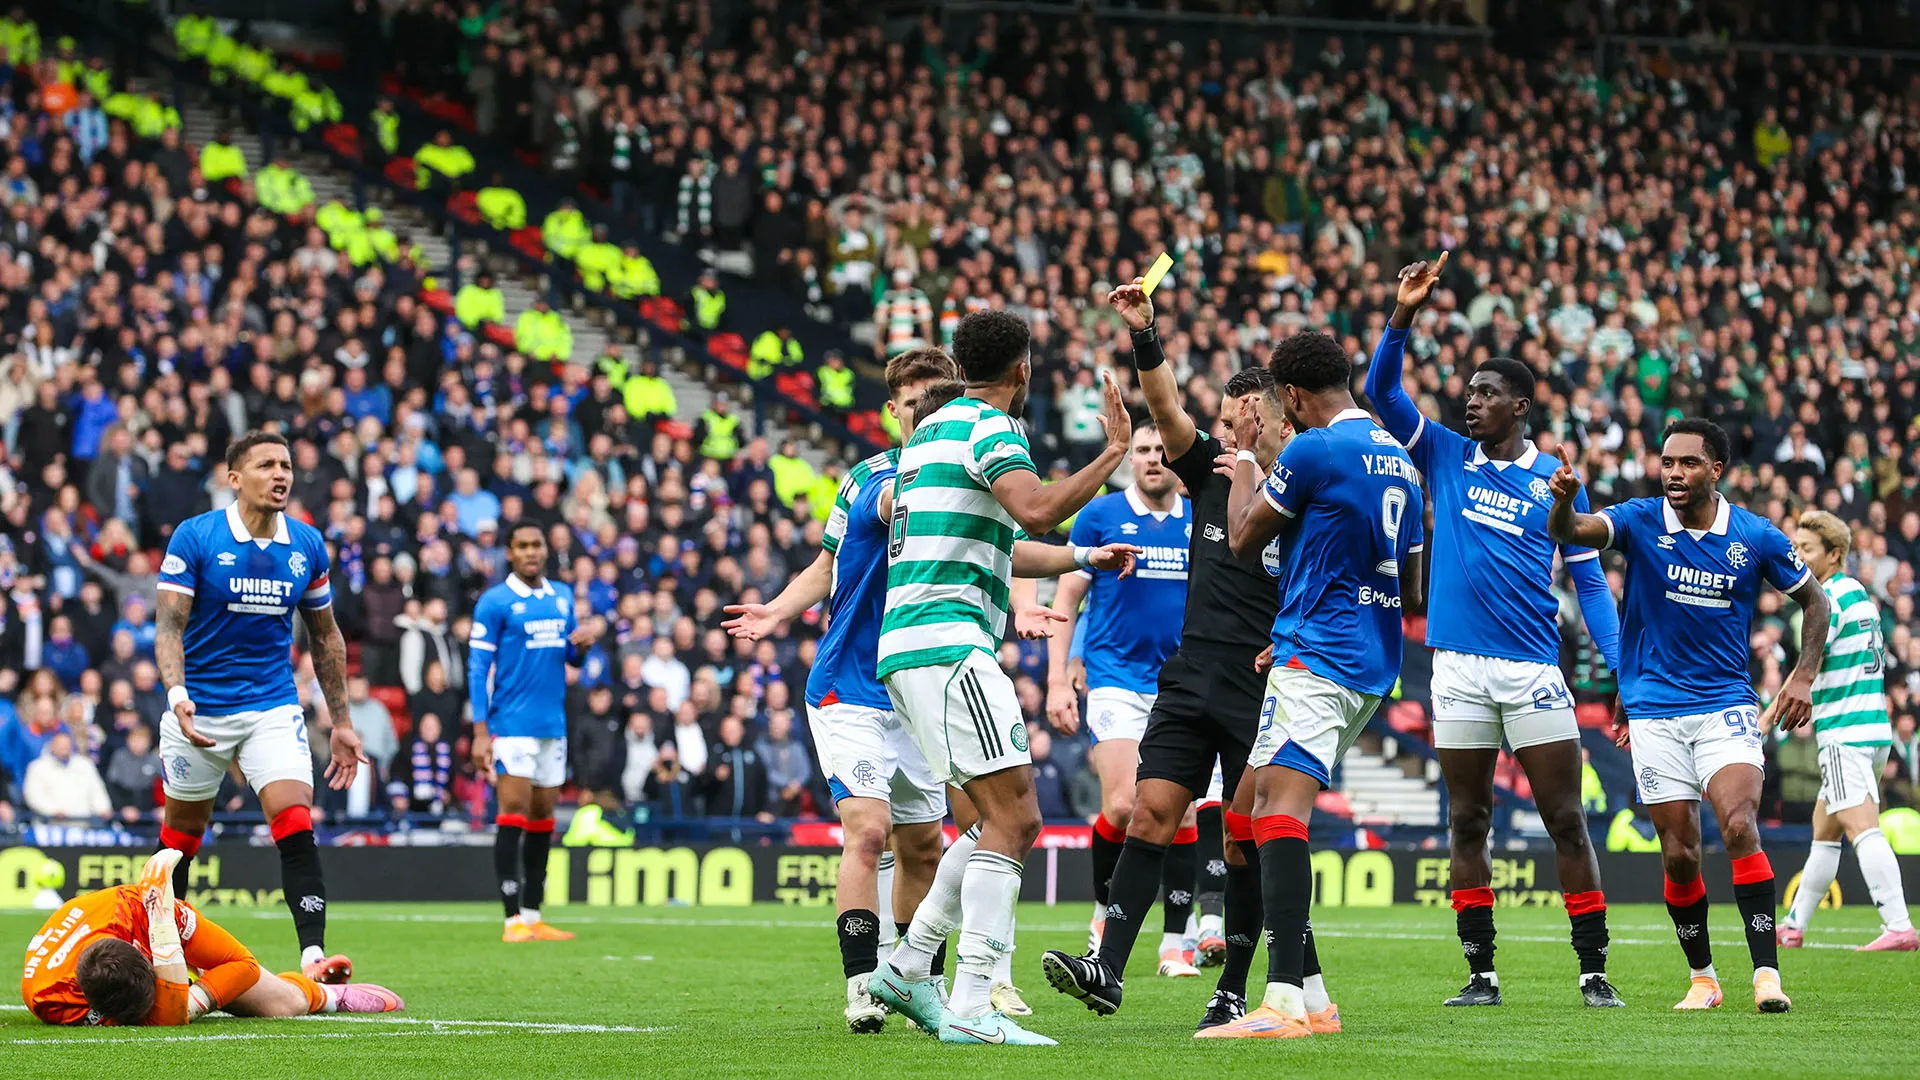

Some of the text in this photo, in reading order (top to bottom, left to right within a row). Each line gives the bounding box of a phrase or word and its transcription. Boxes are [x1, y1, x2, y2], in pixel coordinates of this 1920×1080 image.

[890, 467, 921, 559] 6
[1467, 485, 1534, 516] UNIBET
[1375, 485, 1408, 578] 9
[1136, 545, 1189, 562] UNIBET
[1264, 551, 1280, 561] REFE
[229, 577, 294, 597] UNIBET
[1667, 564, 1738, 590] UNIBET
[1372, 590, 1402, 608] MyG
[1532, 682, 1572, 709] 24
[1259, 696, 1277, 733] 9
